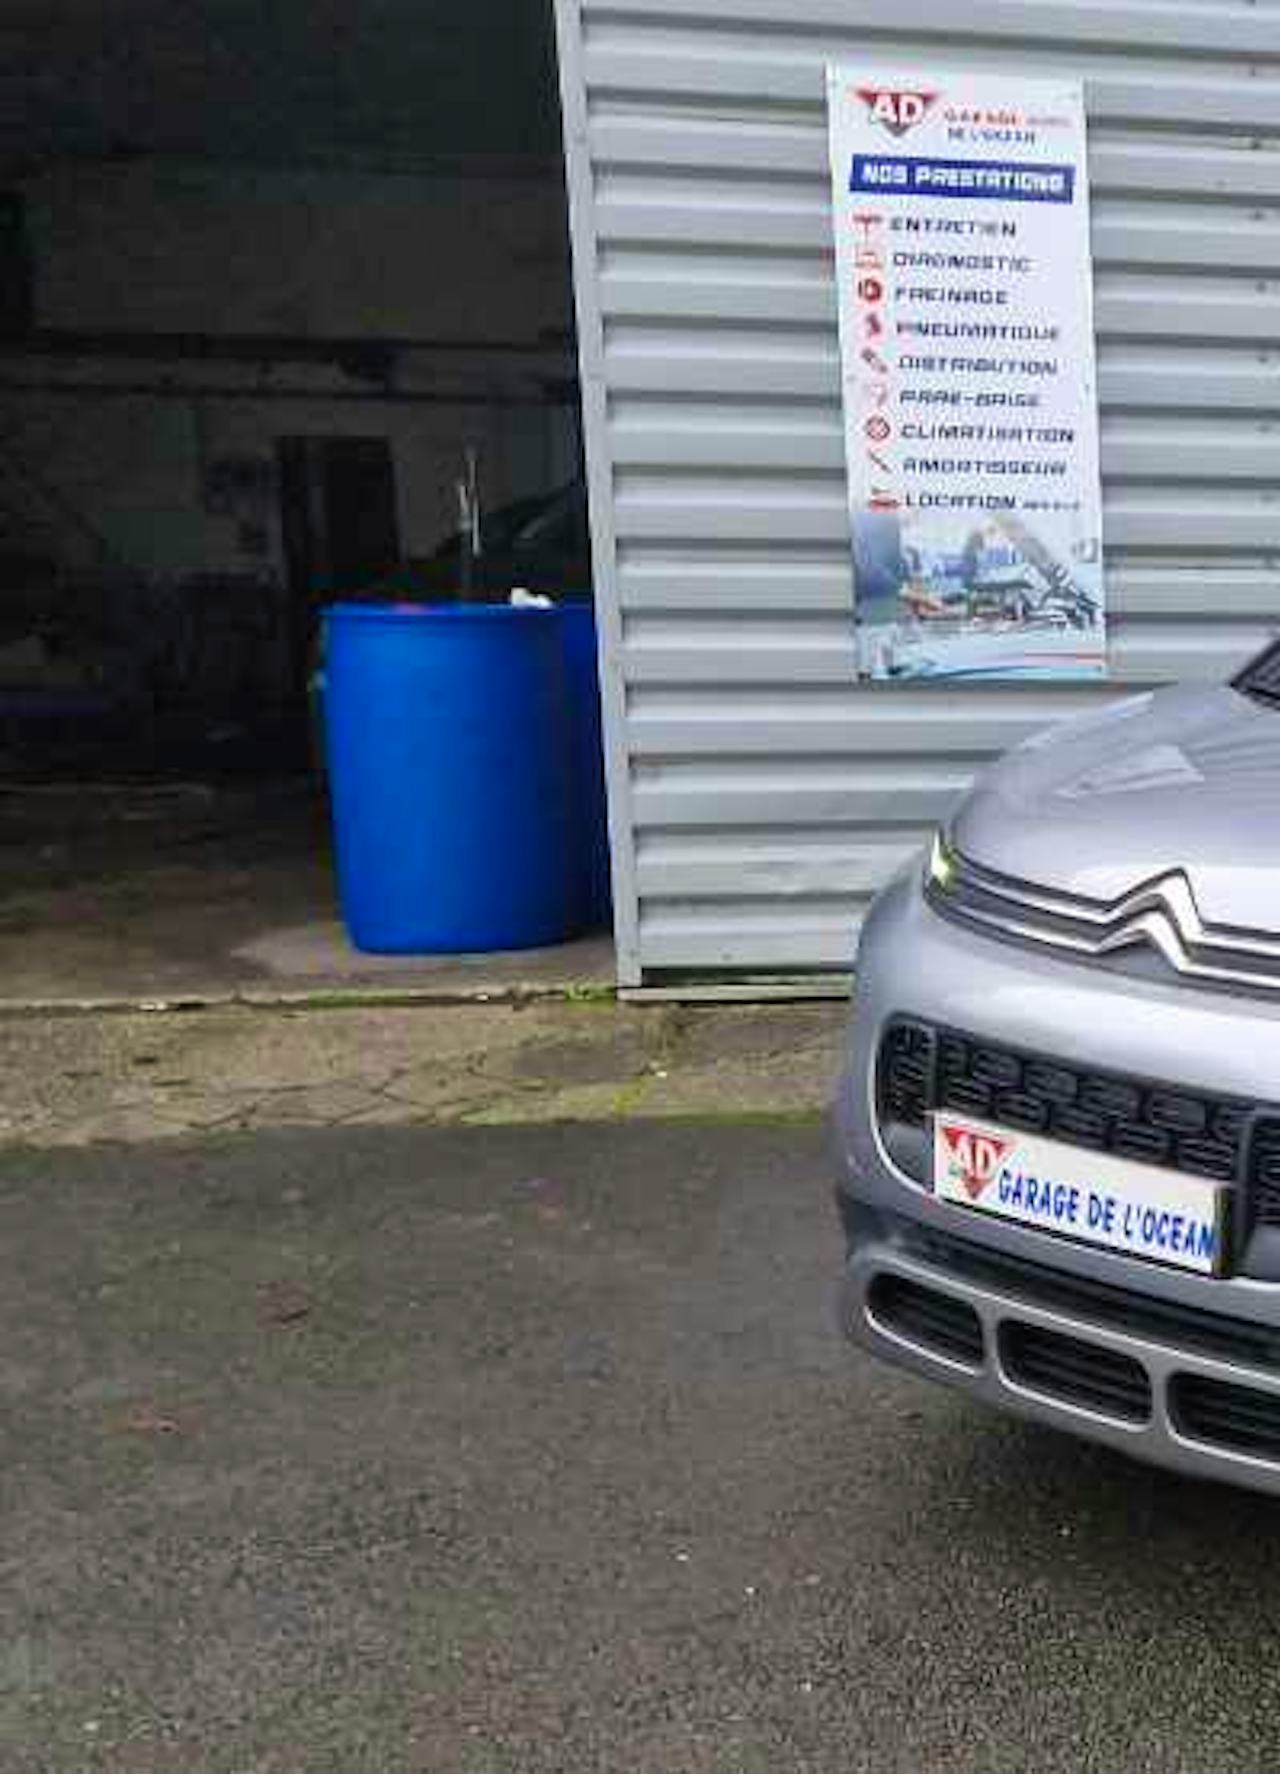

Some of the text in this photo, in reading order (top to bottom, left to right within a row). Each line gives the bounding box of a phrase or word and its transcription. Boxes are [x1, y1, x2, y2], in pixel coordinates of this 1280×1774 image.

[873, 93, 924, 124] AD
[861, 162, 1066, 193] NOS PRESTATIONS
[890, 216, 1017, 238] ENTRETIEN
[893, 251, 1034, 273] DIAGNOSTIC
[895, 286, 1009, 304] FREINAGE
[896, 321, 1059, 341] PNEUMATIQUE
[898, 354, 1059, 377] DISTRIBUTION
[899, 388, 1041, 408] PARE-BRISE
[900, 423, 1075, 443] CLIMATISATION
[902, 456, 1067, 477] AMORTISSEUR
[905, 491, 1016, 510] LOCATION
[953, 1133, 1216, 1258] AD GARAGE DE L'OCEAN
